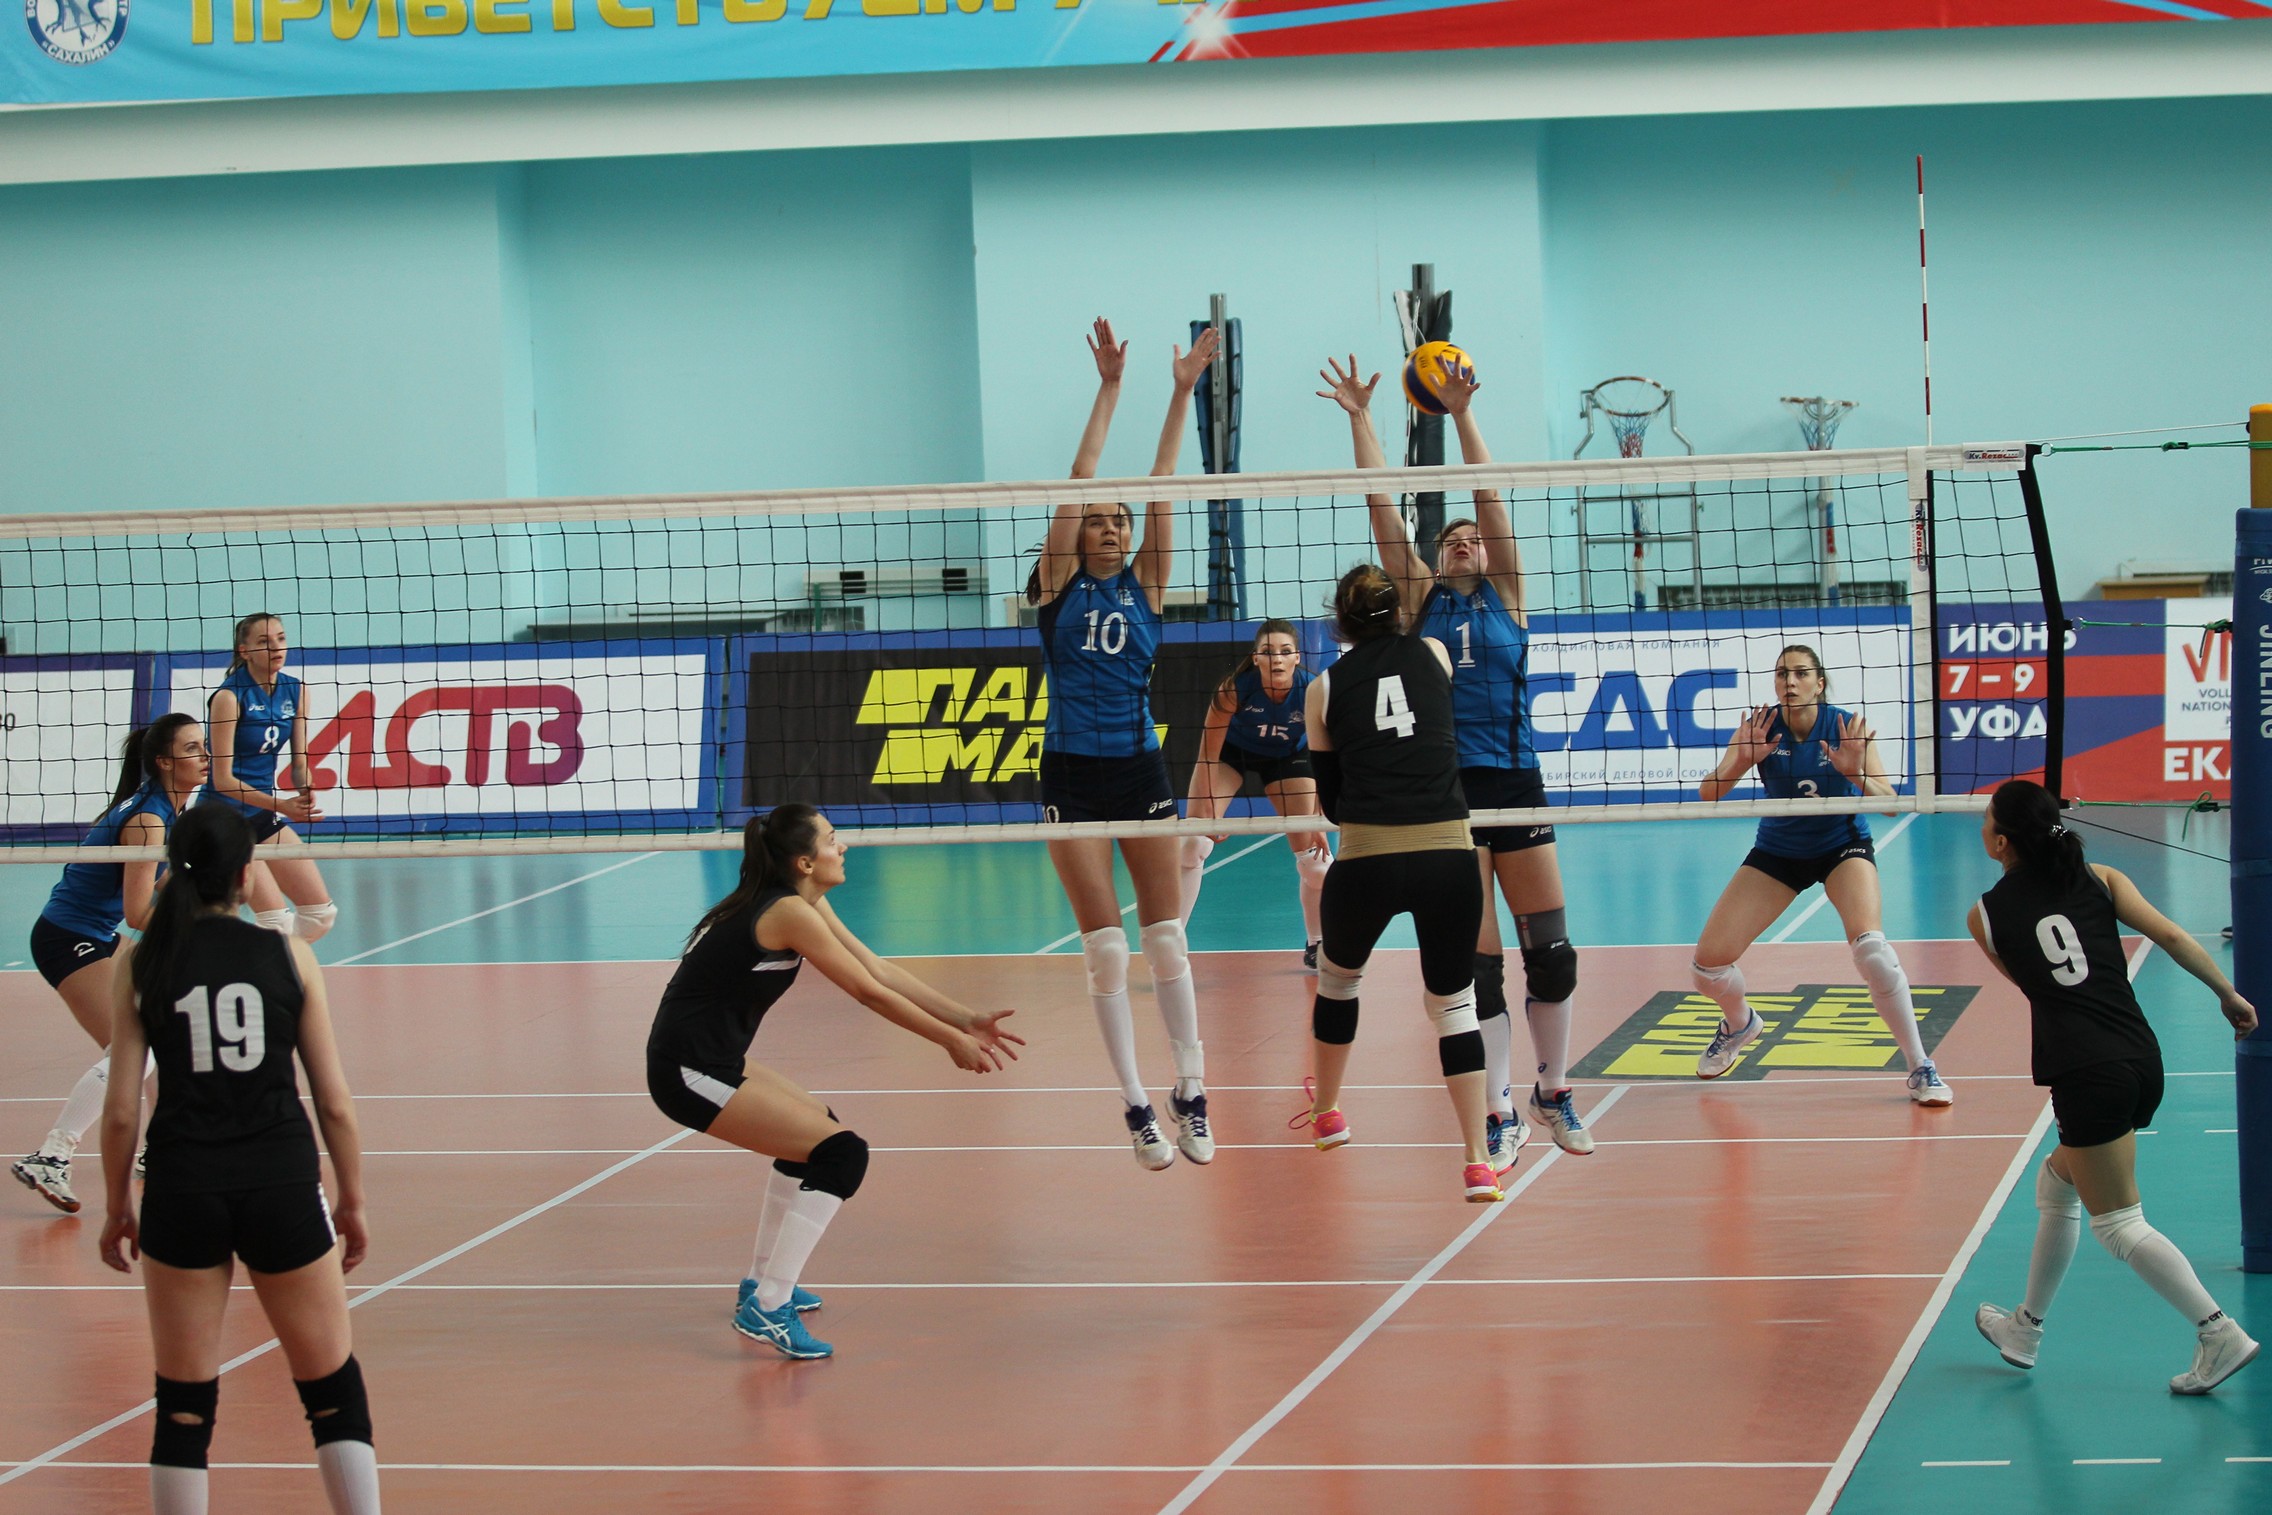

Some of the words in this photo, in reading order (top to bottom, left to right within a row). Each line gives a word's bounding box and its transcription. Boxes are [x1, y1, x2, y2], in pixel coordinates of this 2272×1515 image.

[1080, 609, 1128, 655] 10
[1455, 621, 1476, 664] 1
[1642, 640, 1721, 650] КОМПАНИЯ
[1375, 674, 1416, 738] 4
[1949, 704, 2047, 741] УФА
[259, 725, 280, 754] 8
[1257, 724, 1289, 741] 15
[1541, 769, 1606, 781] БИРСКИЙ
[1681, 769, 1715, 778] СОЮ
[2163, 746, 2231, 782] ЕК
[2036, 914, 2089, 987] 9
[174, 982, 266, 1073] 19
